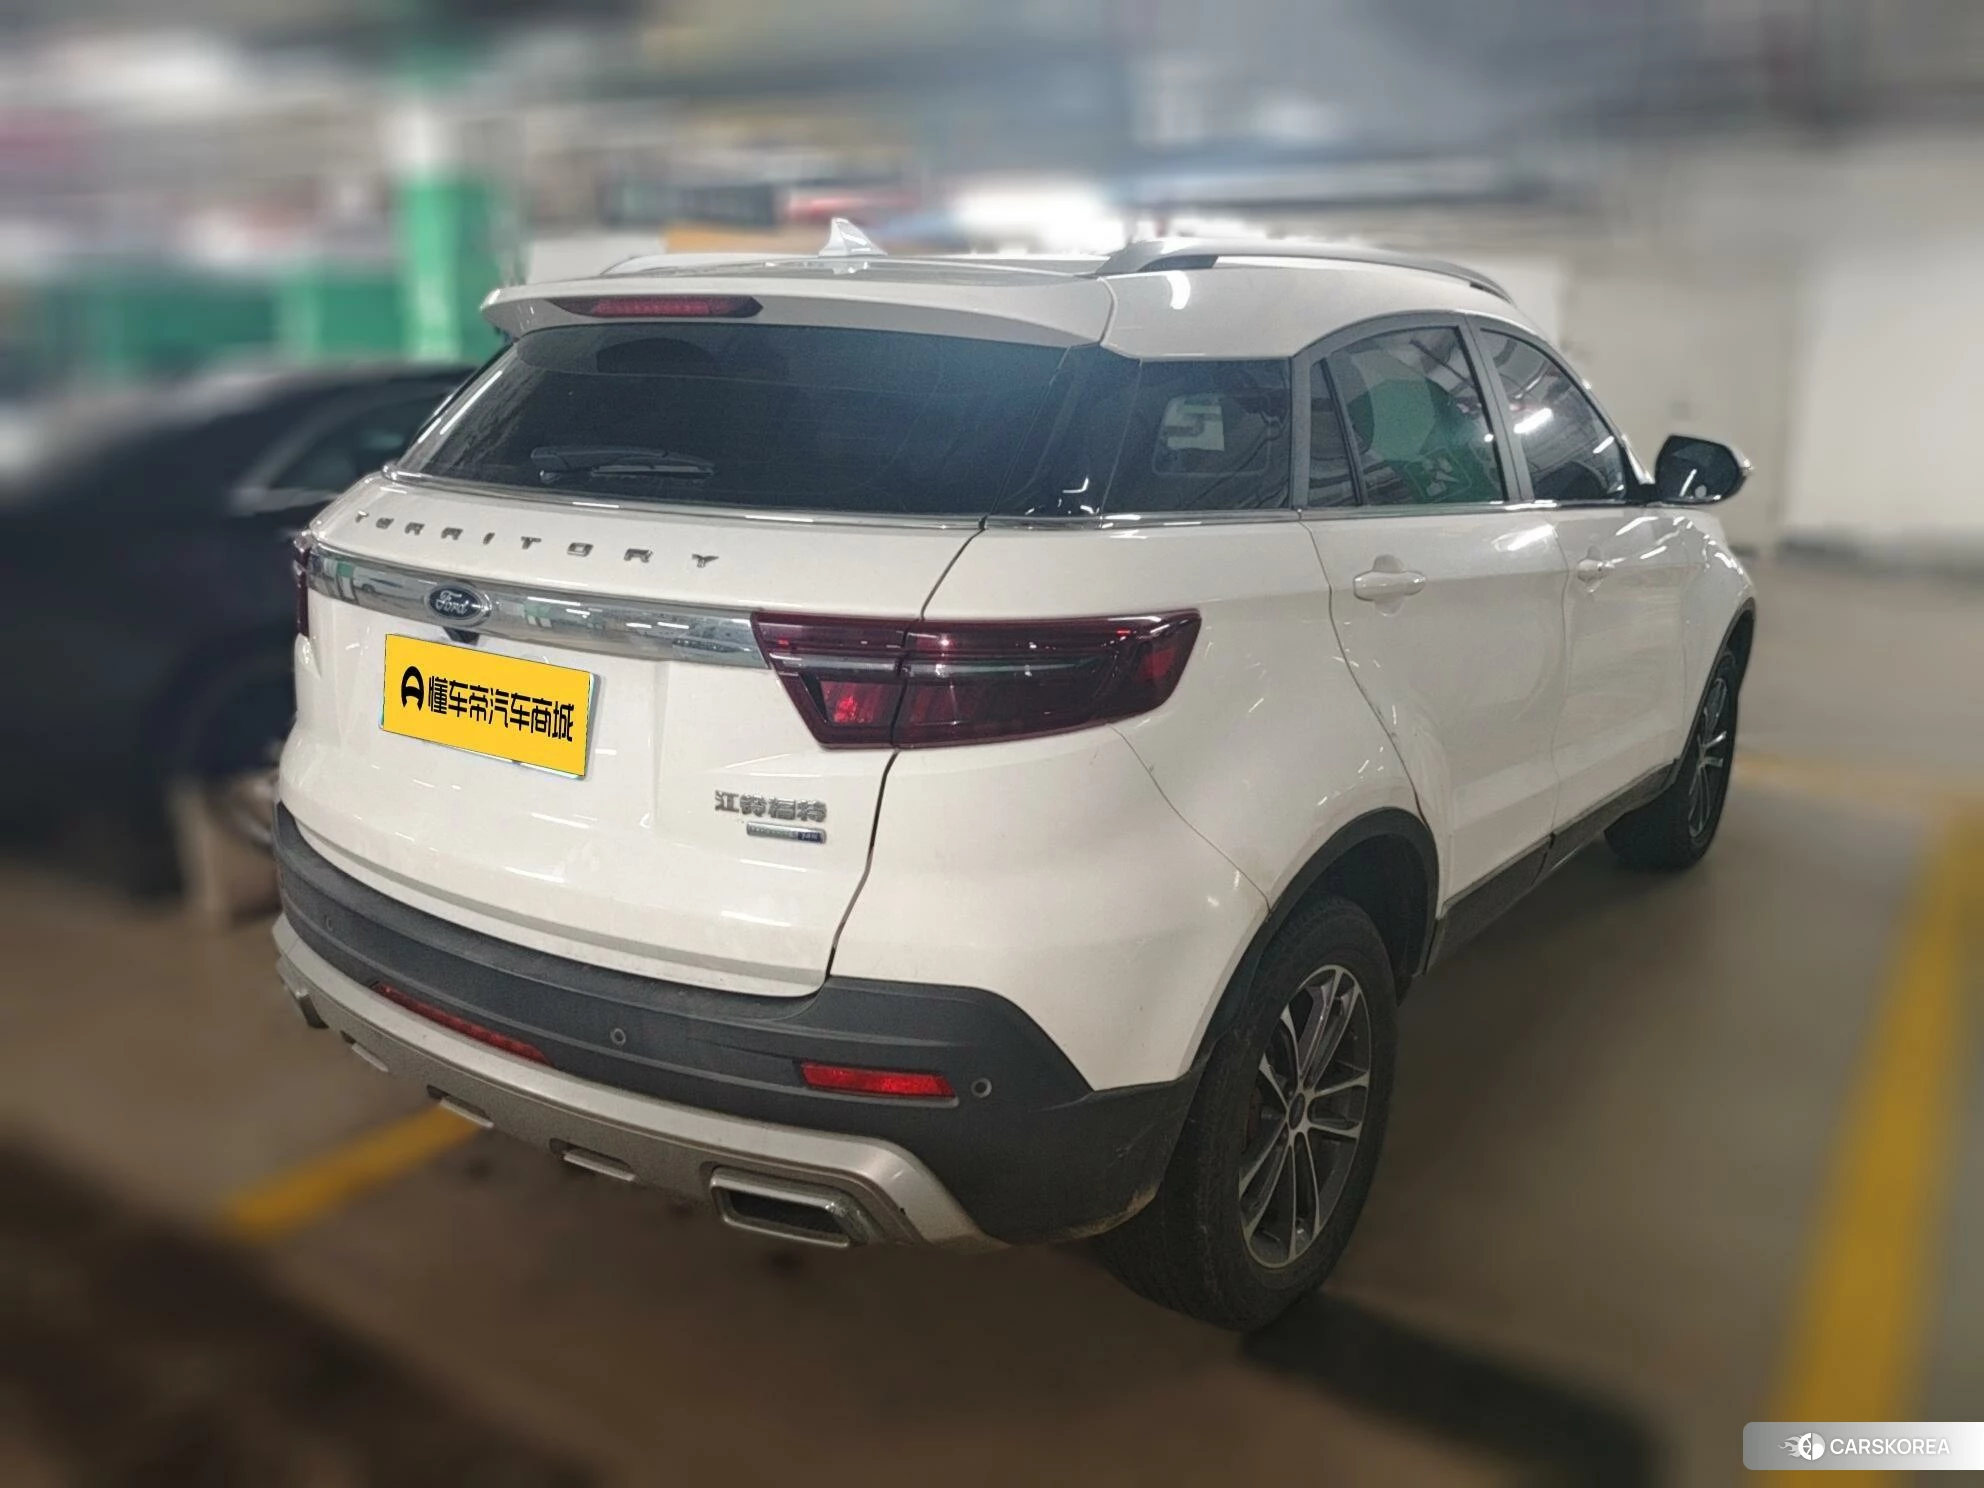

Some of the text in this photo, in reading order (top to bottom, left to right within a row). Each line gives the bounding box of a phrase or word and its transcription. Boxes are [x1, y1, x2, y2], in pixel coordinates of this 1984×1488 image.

[355, 509, 720, 568] TERRITORY
[435, 590, 469, 615] Ford
[714, 789, 827, 823] 江铃福特
